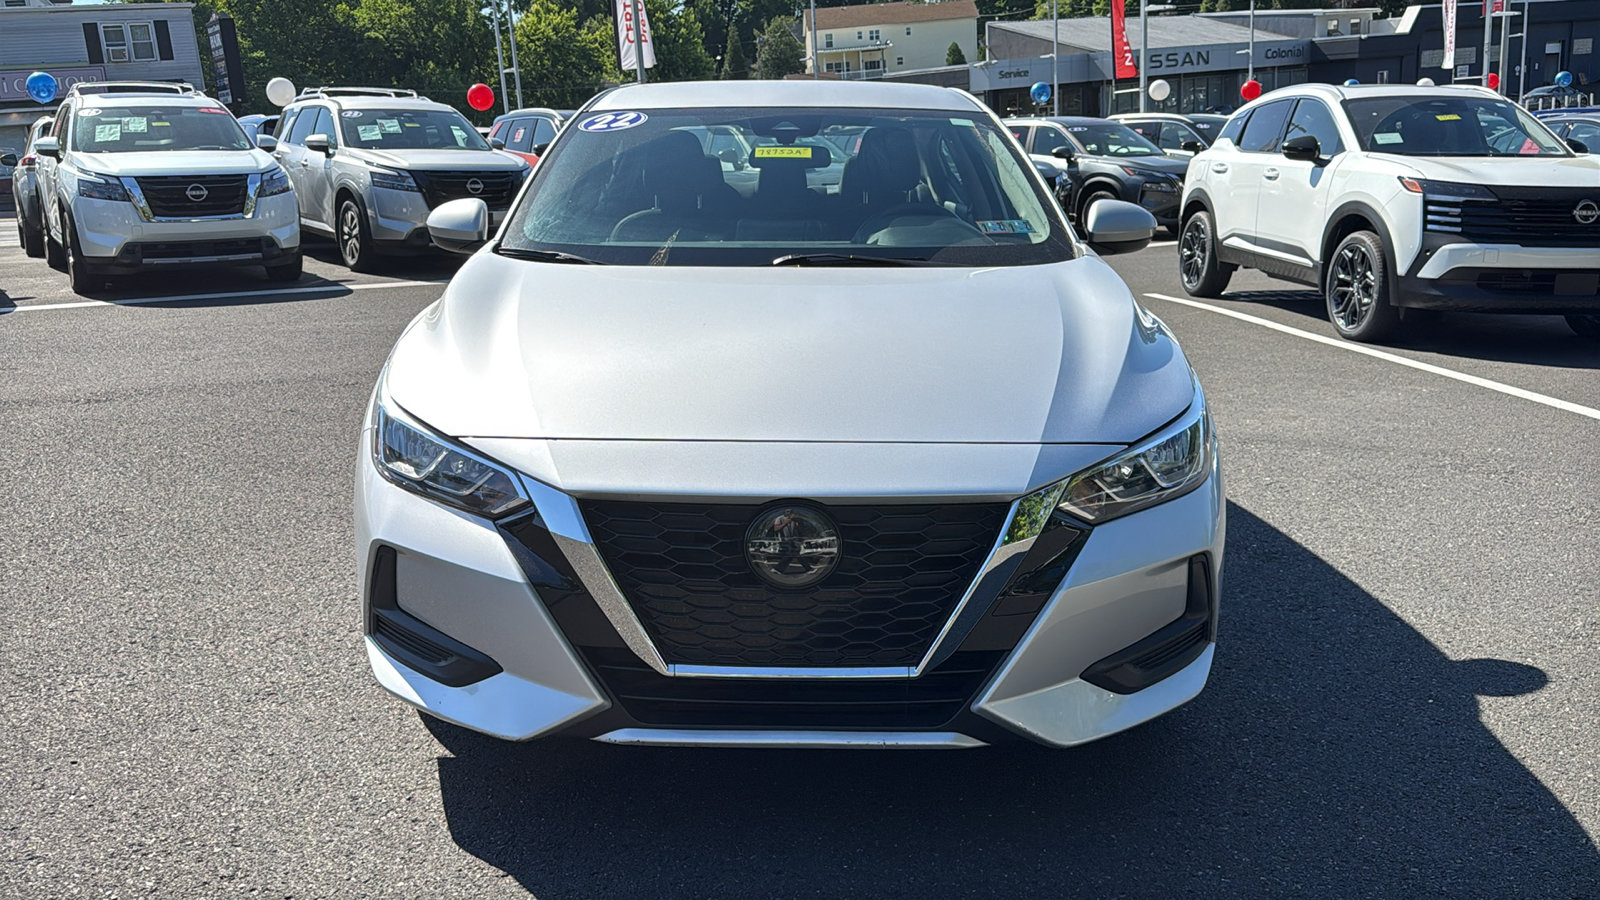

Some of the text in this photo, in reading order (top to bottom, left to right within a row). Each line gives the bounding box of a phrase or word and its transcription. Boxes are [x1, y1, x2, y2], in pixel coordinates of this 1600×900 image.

[1264, 46, 1305, 60] Colonial
[998, 68, 1029, 79] Service
[587, 112, 638, 130] 22
